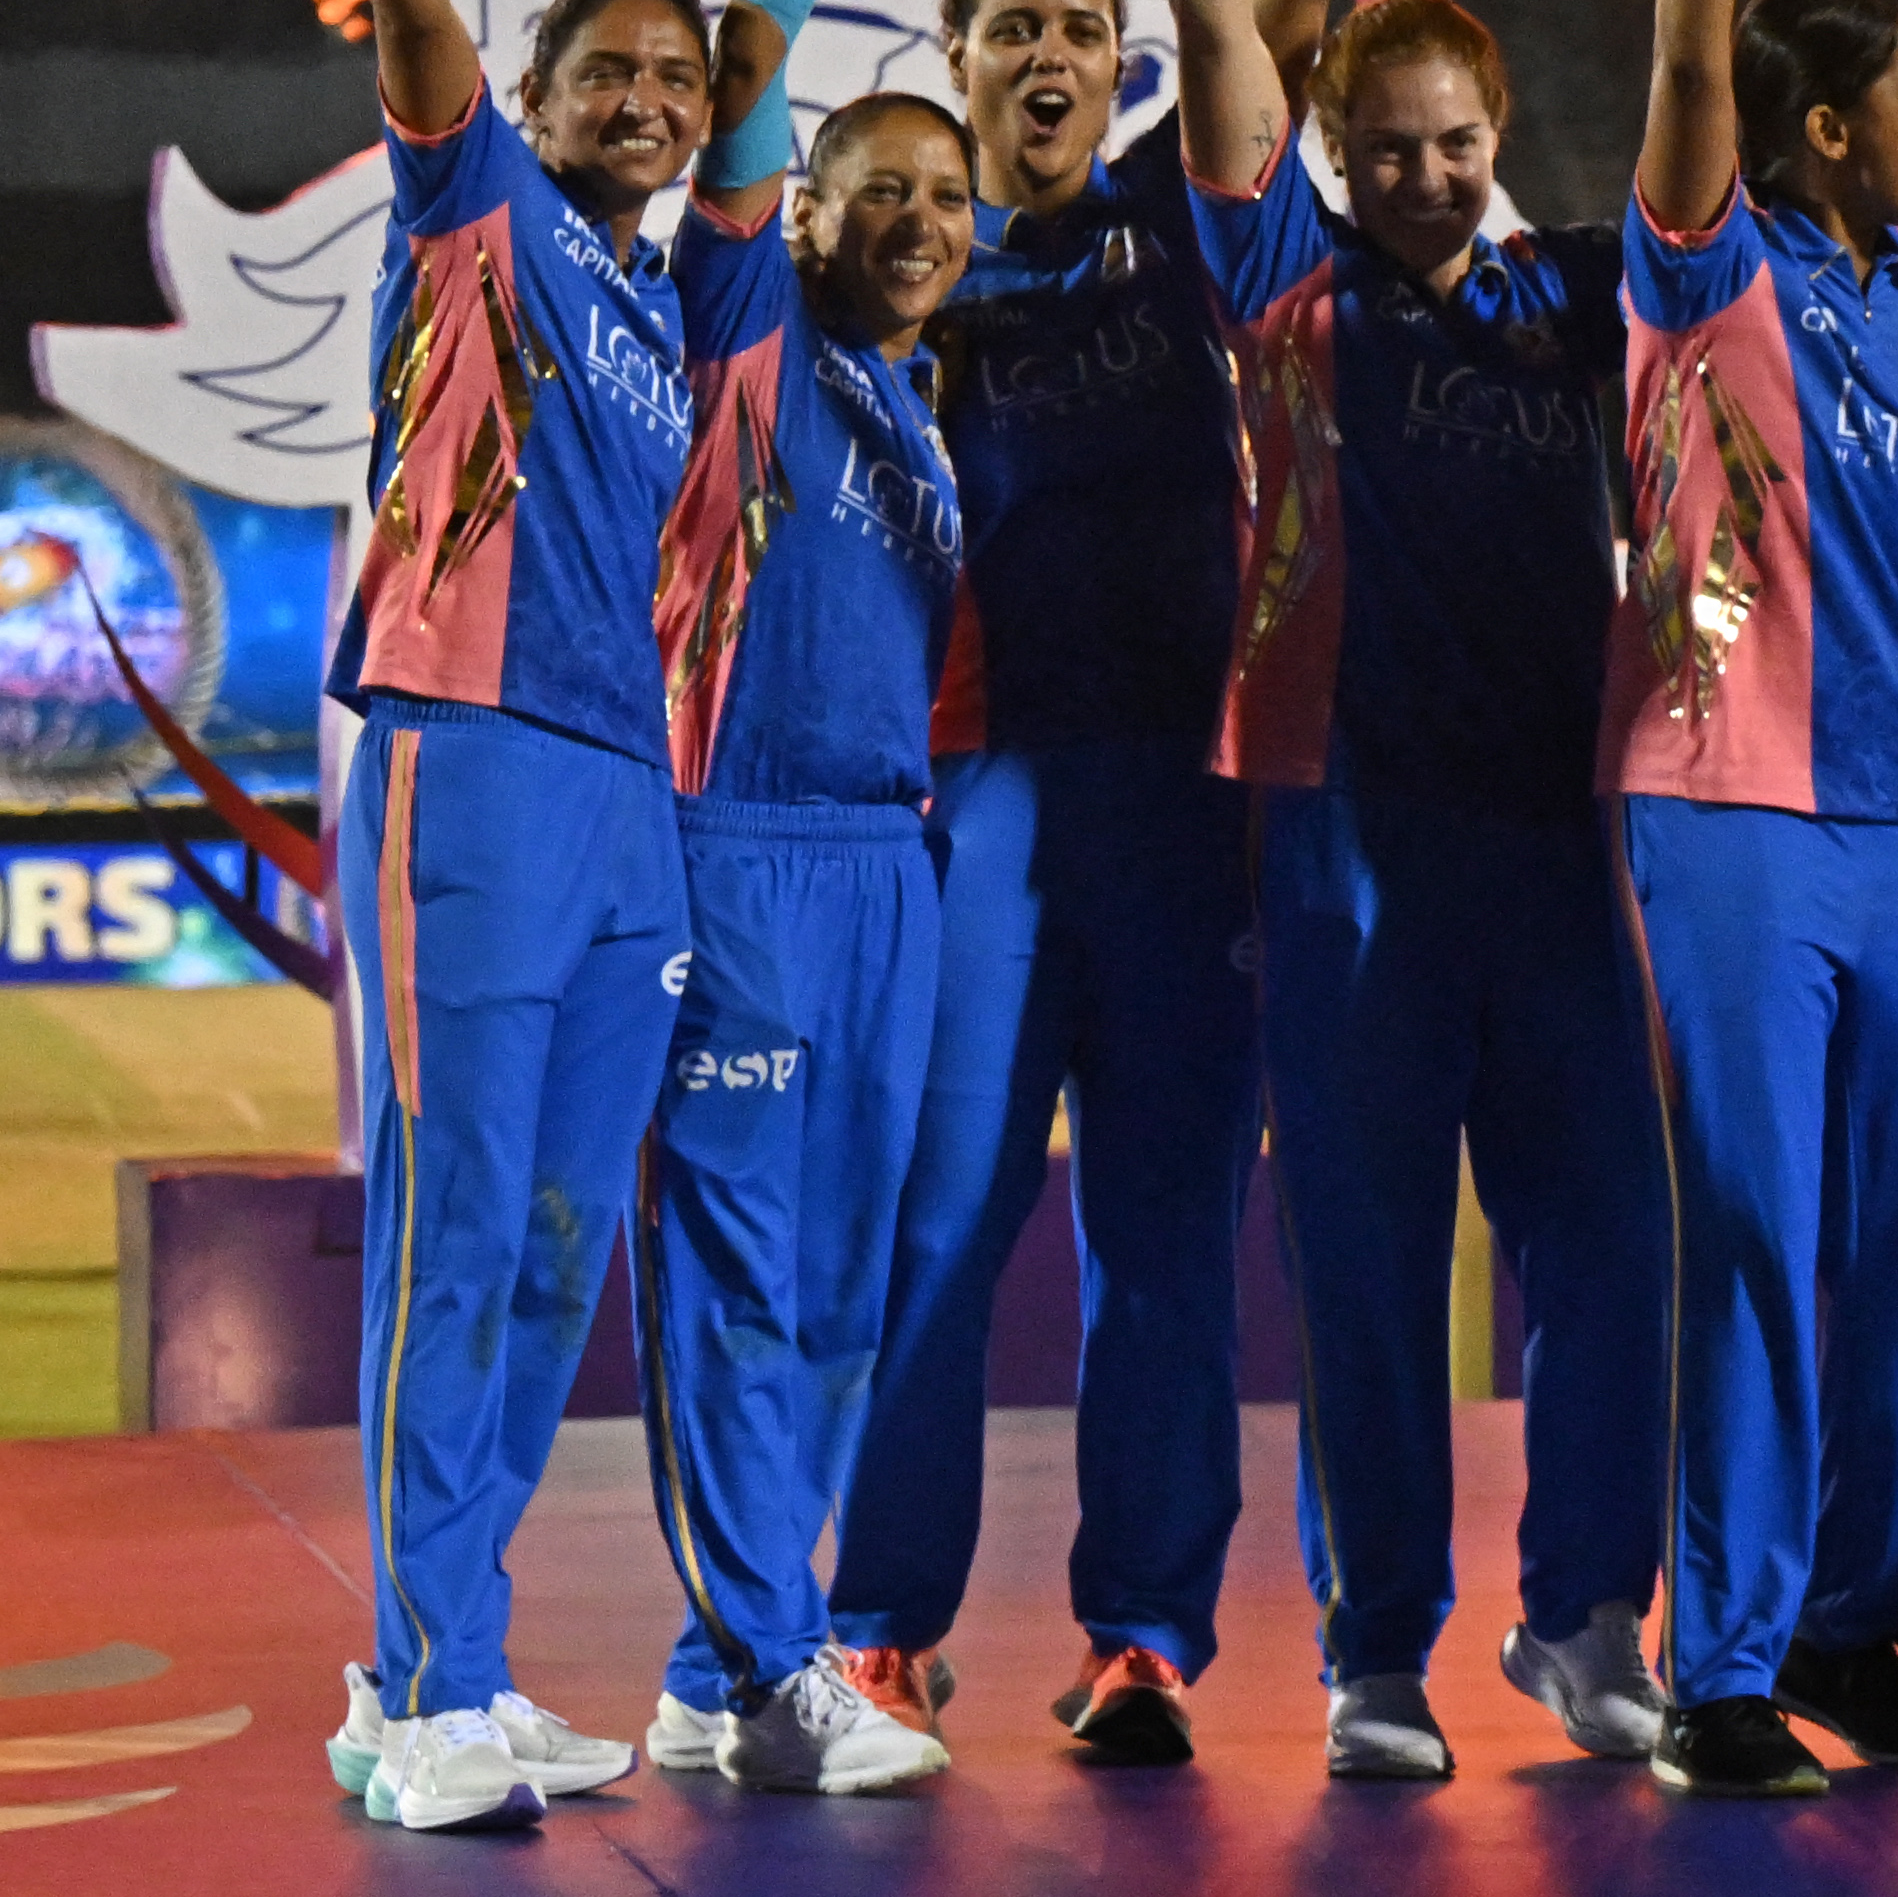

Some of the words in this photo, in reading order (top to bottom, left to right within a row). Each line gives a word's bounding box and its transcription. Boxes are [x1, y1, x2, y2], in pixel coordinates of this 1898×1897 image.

[588, 303, 693, 428] LOTU
[840, 438, 958, 556] LOTU
[0, 855, 177, 963] RS
